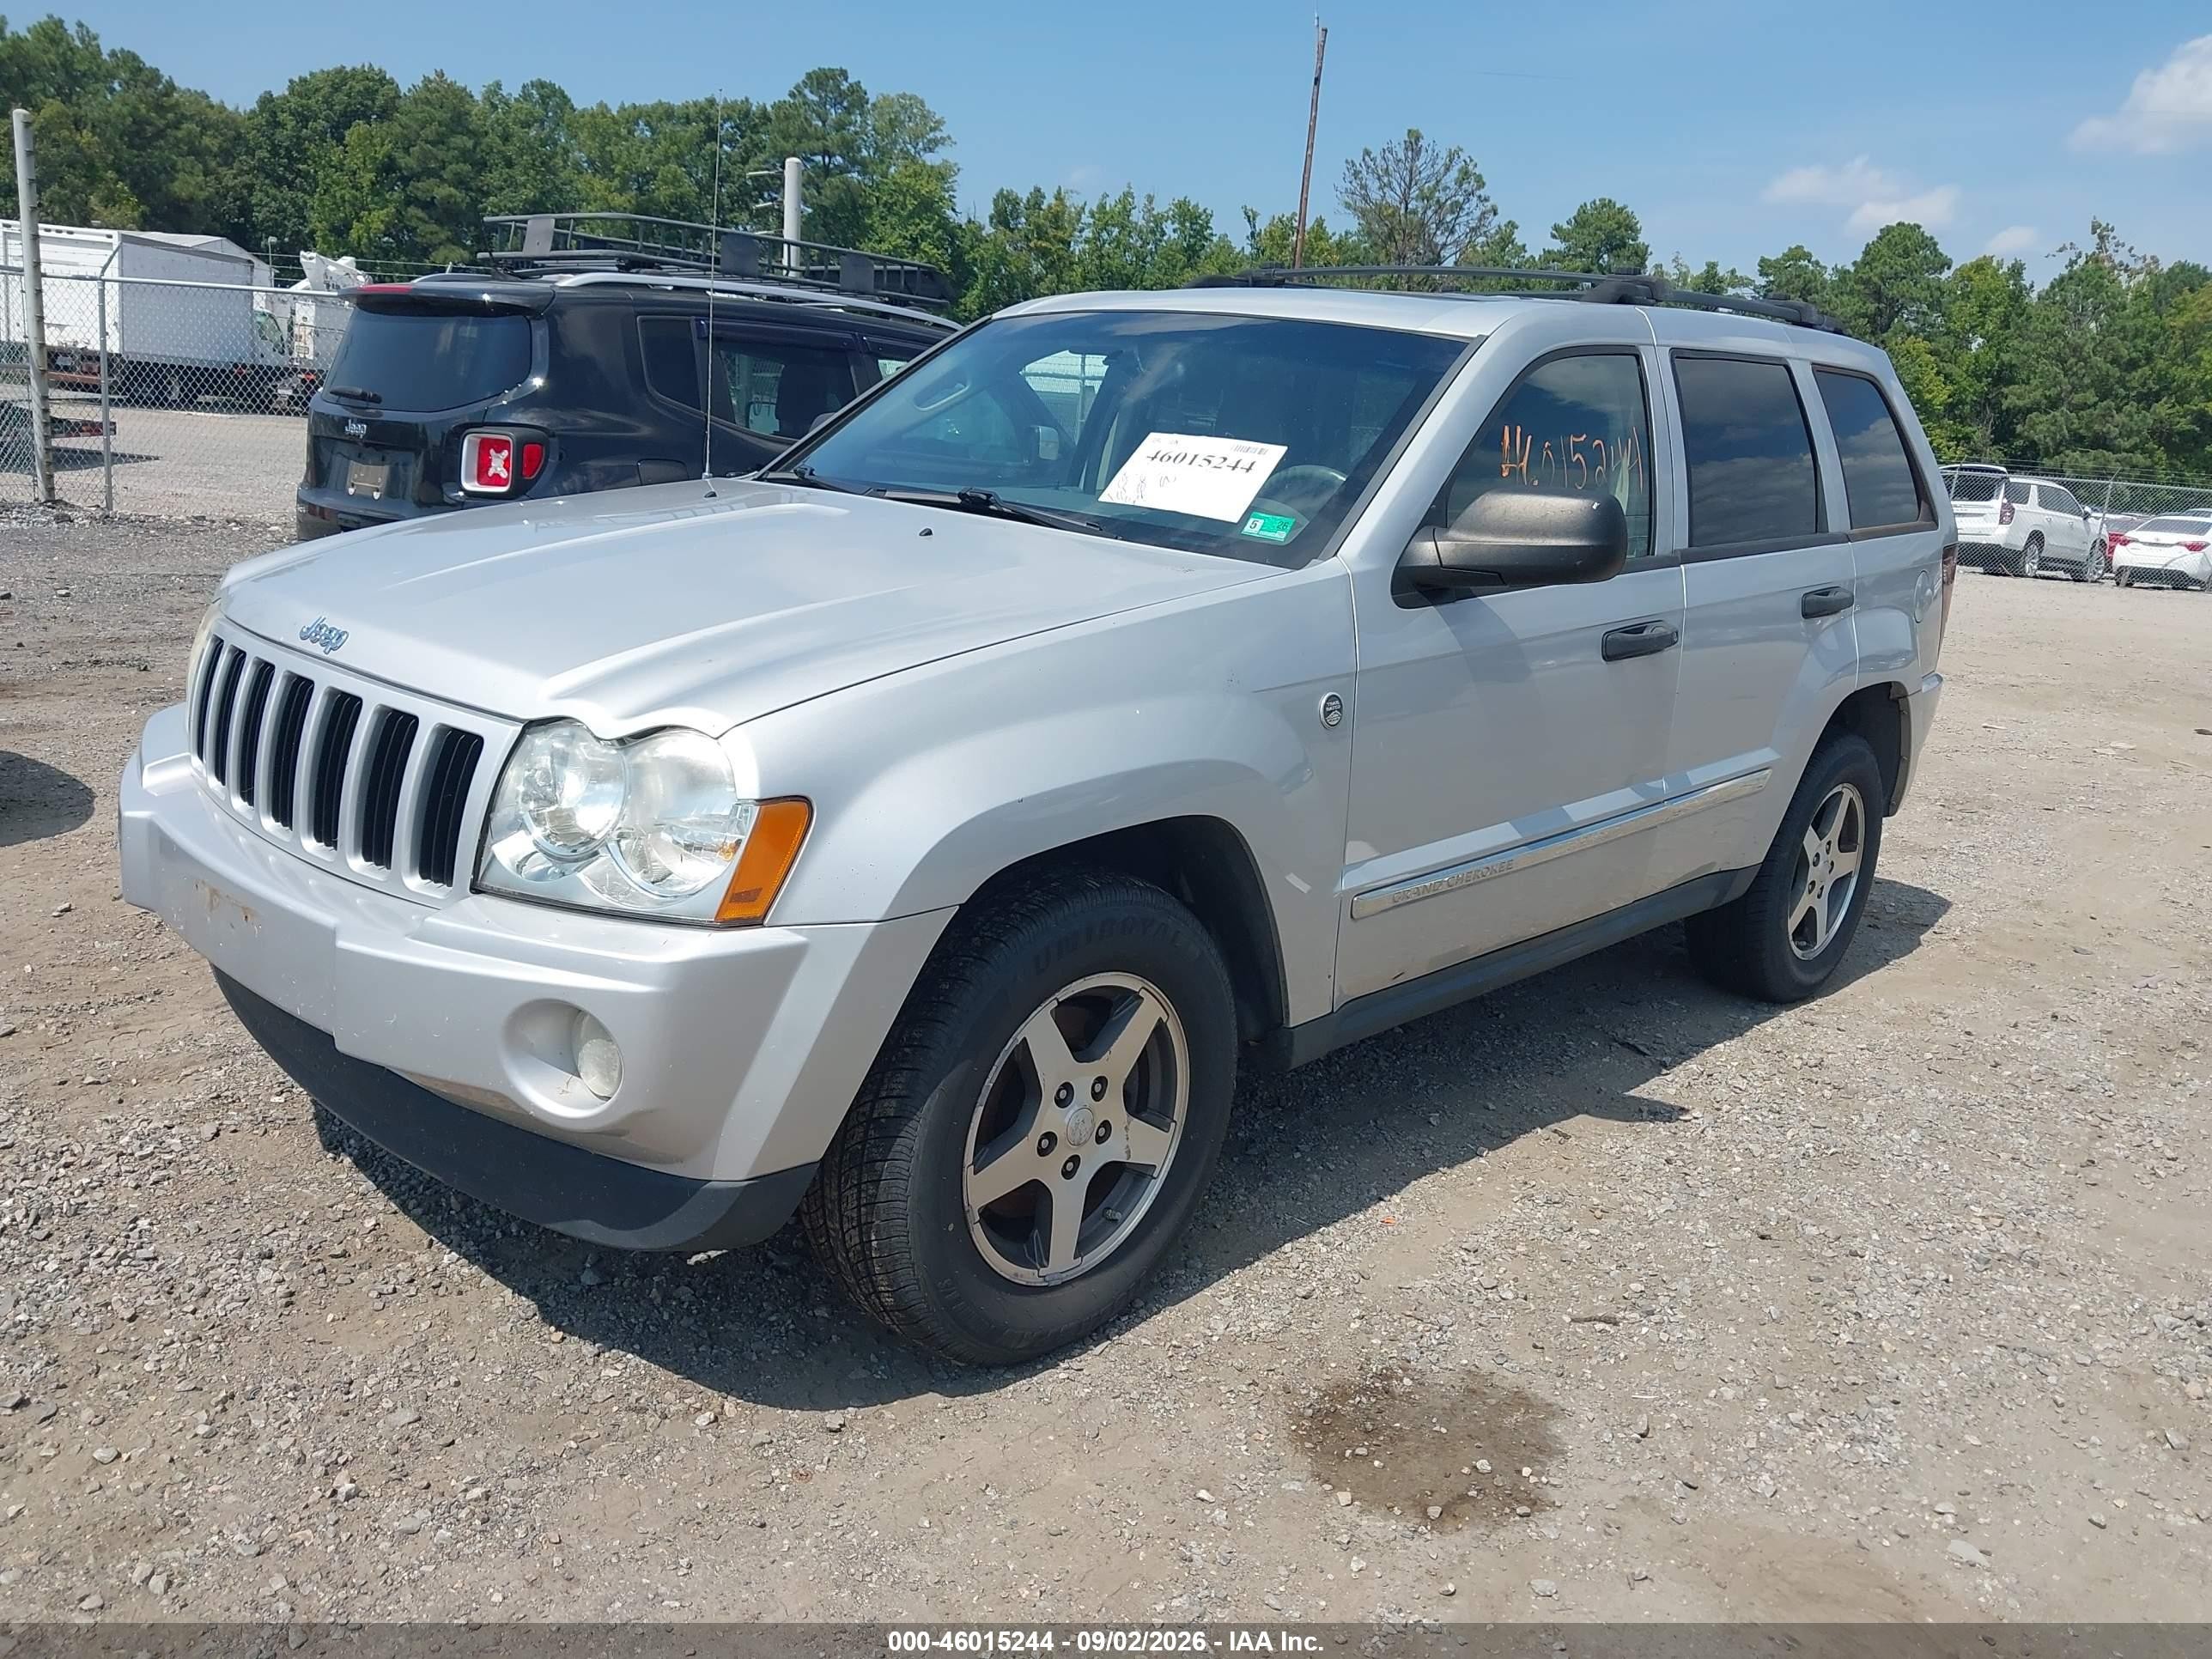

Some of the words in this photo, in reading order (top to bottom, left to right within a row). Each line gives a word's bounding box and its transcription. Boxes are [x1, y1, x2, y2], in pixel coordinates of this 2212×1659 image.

[344, 418, 367, 439] Jeep
[1146, 449, 1257, 473] 46015244
[1249, 520, 1259, 530] 5
[299, 616, 349, 655] Jeep
[1393, 881, 1443, 903] GRAND
[1446, 859, 1514, 888] CHEROKEE
